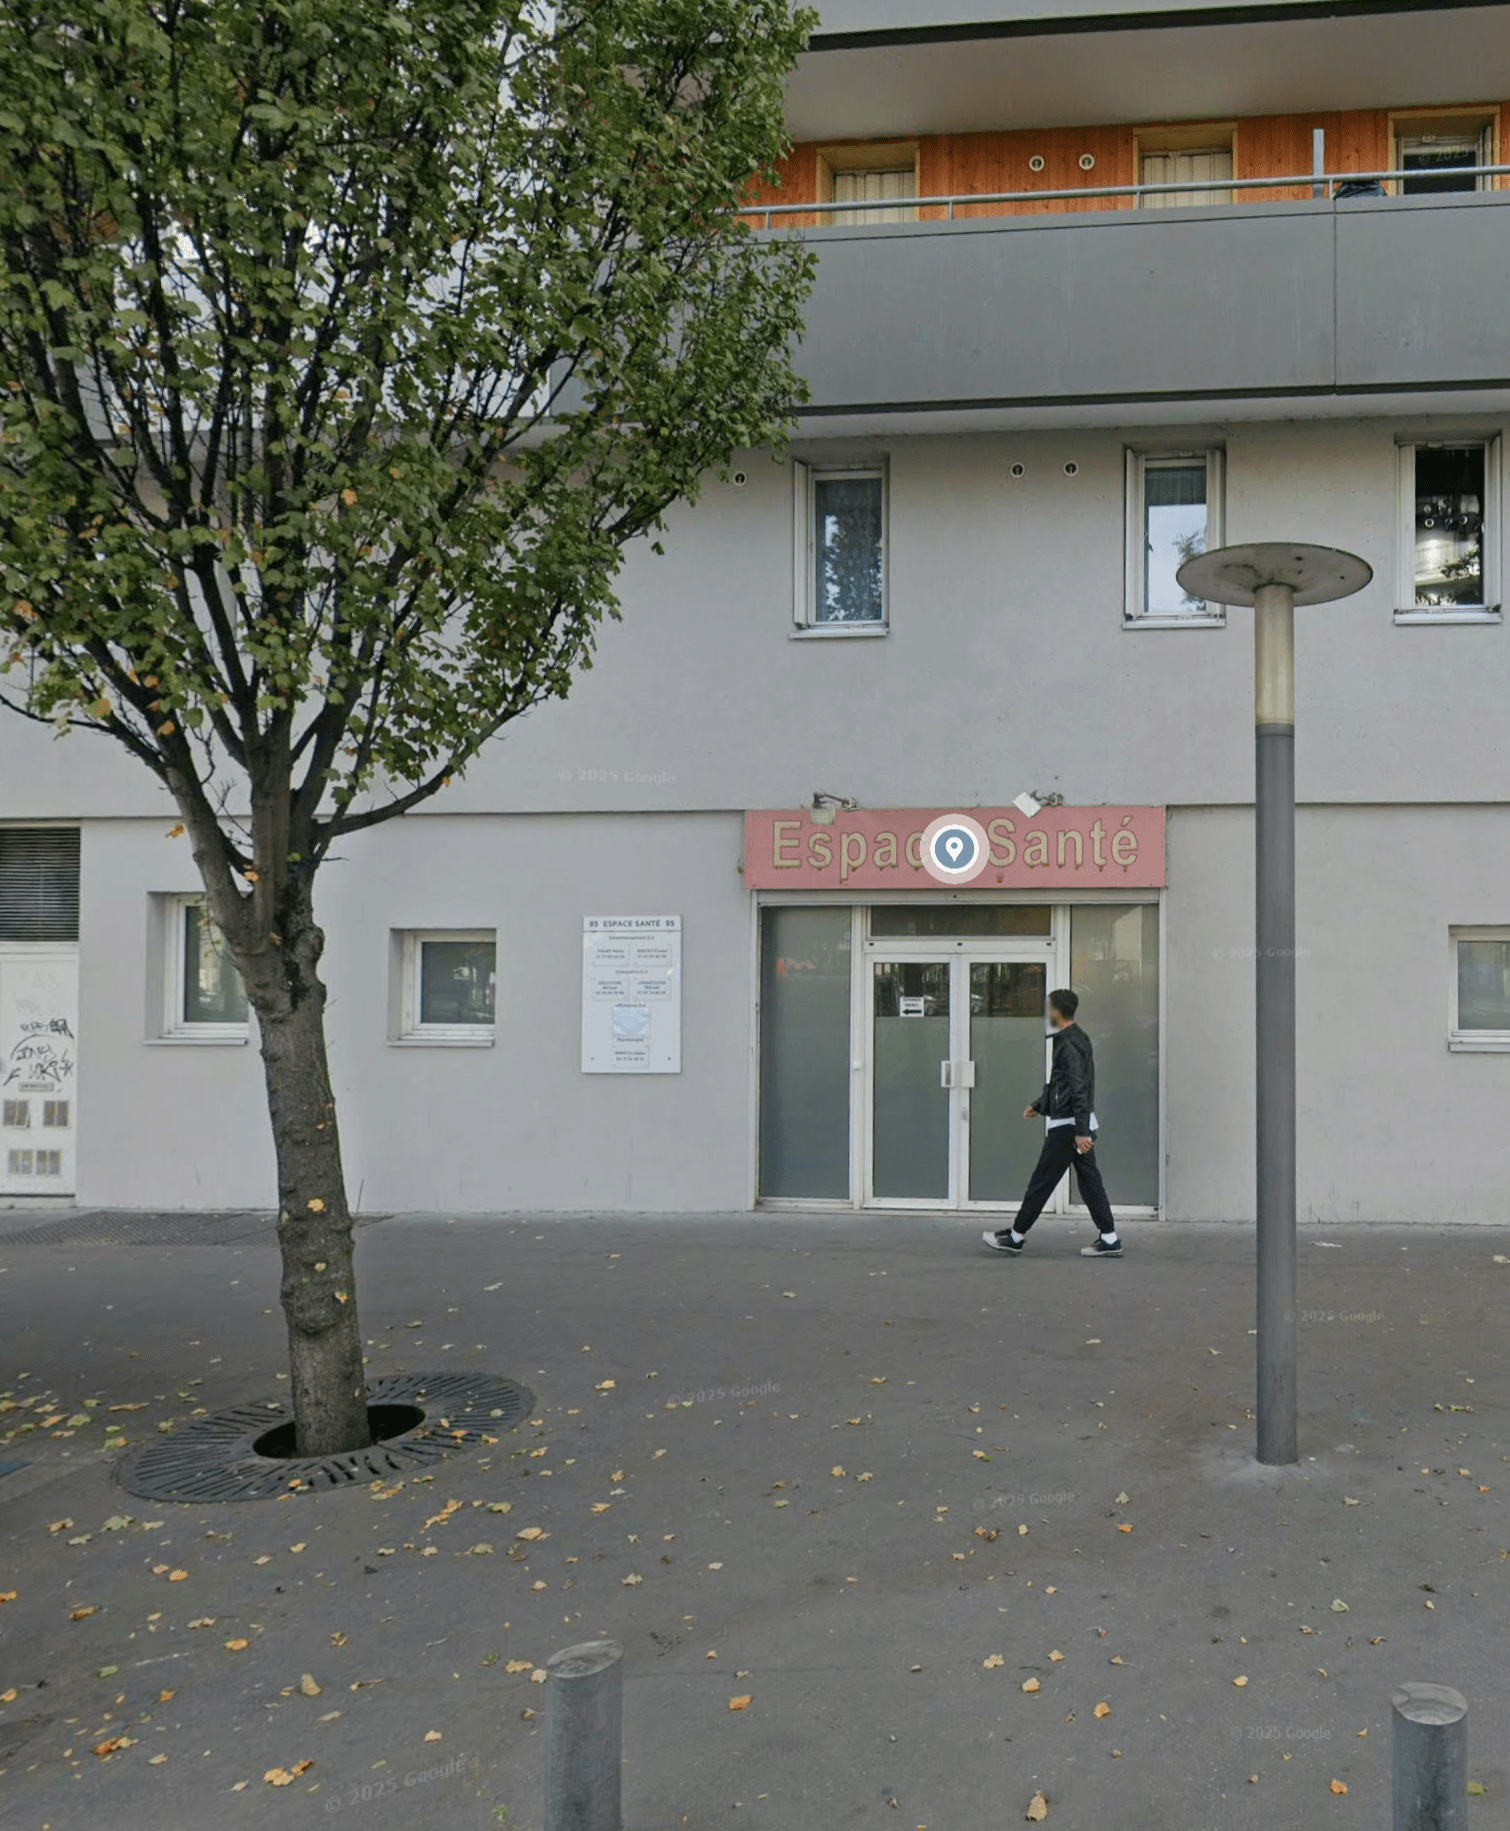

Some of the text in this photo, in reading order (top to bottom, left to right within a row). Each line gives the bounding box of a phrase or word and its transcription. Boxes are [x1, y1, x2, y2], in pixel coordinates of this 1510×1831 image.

[772, 815, 1139, 884] Espac Santé
[589, 918, 675, 928] 95 ESPACE SANTÉ 95
